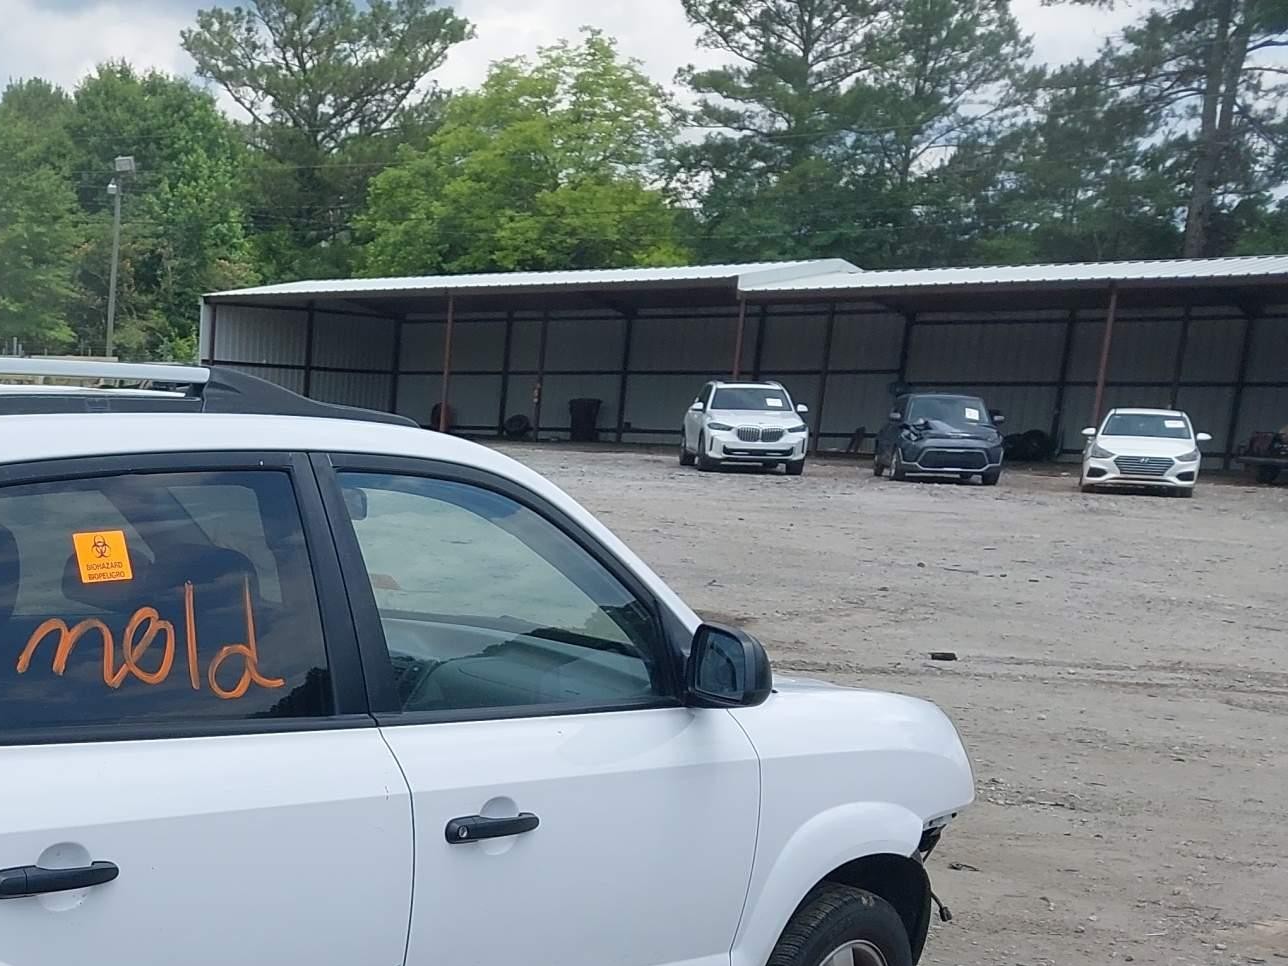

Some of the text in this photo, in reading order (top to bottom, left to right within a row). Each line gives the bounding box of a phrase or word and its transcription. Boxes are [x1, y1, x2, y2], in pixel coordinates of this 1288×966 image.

[86, 561, 123, 571] BIOHAZARD
[88, 571, 125, 580] BIOPELIGRO
[16, 575, 285, 699] mold
